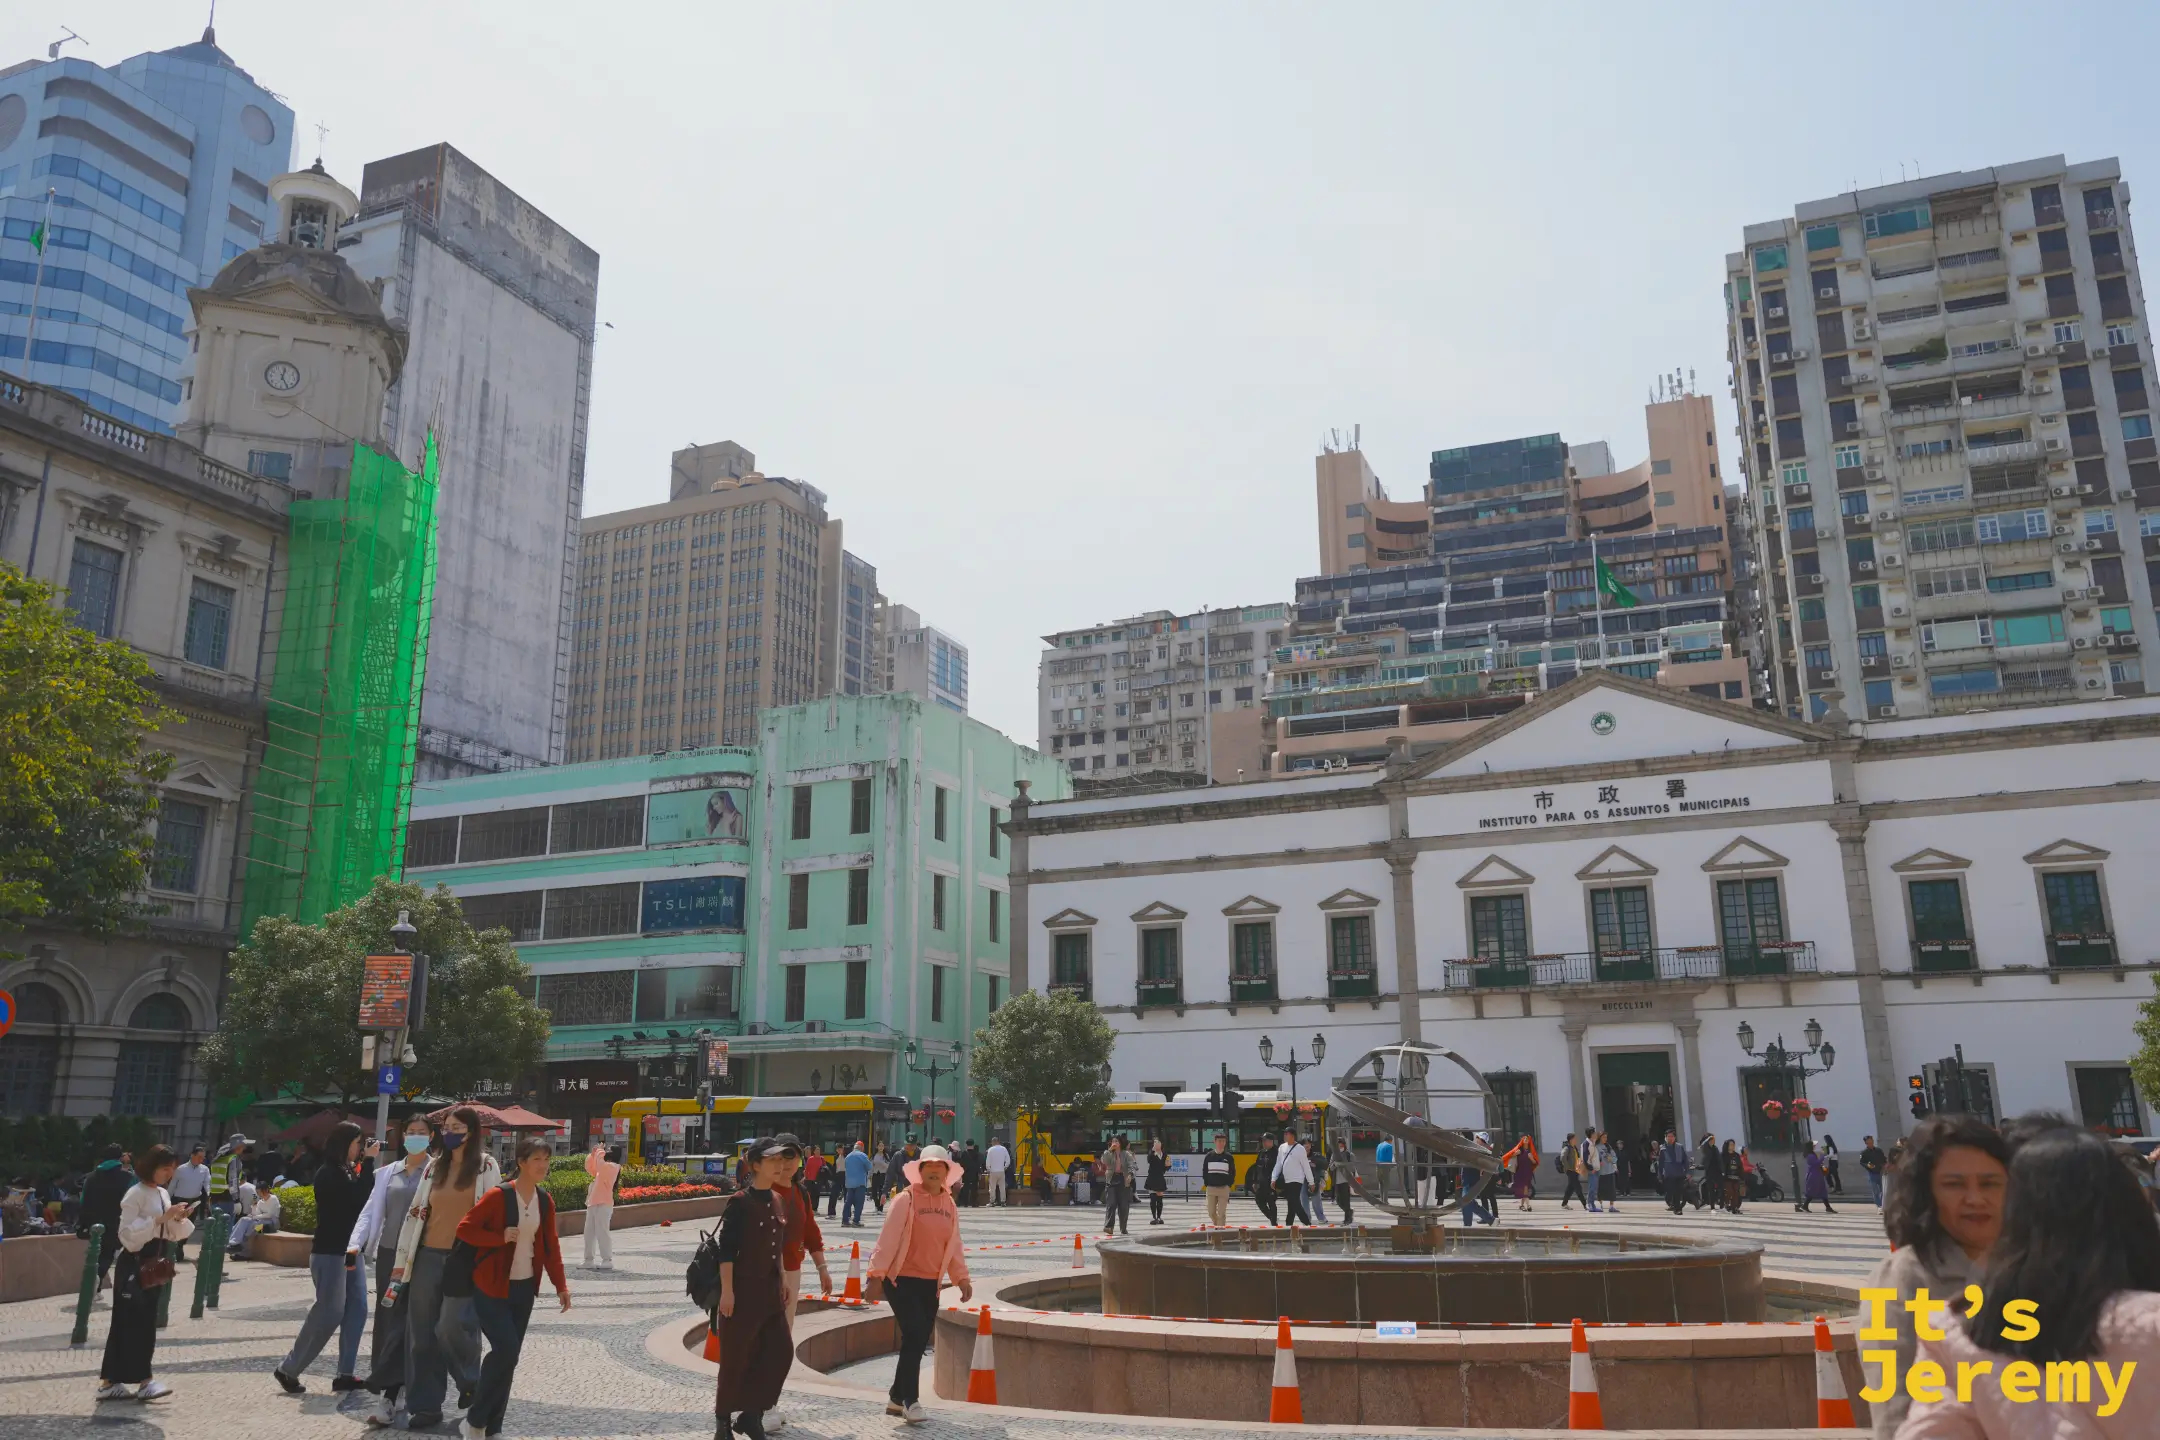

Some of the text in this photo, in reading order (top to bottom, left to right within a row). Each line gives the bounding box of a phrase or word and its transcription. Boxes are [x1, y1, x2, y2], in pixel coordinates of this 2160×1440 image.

[1533, 779, 1687, 810] 市政署
[1479, 797, 1750, 828] INSTITUTO PARA OS ASSUNTOS MUNICIPAIS
[653, 898, 687, 911] TSL
